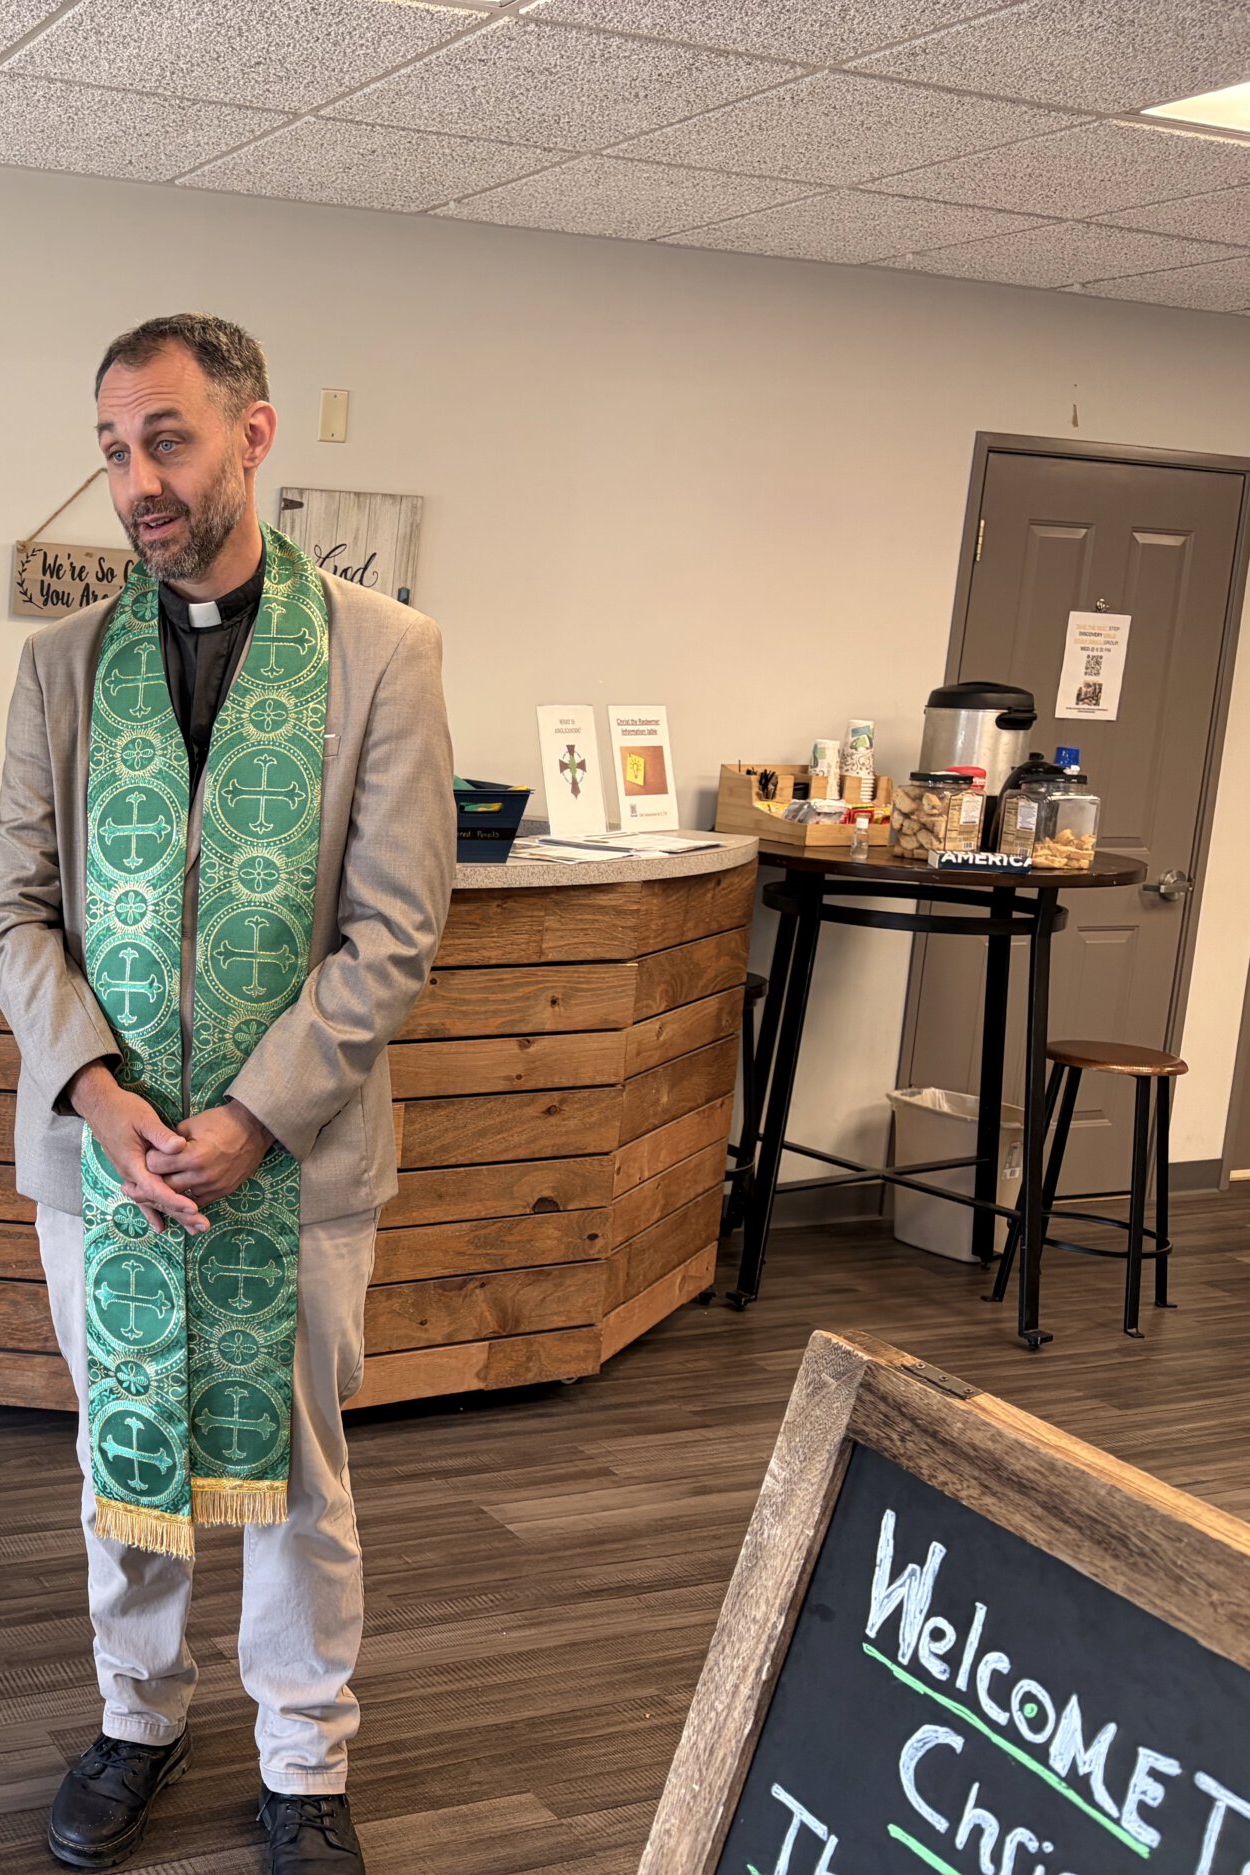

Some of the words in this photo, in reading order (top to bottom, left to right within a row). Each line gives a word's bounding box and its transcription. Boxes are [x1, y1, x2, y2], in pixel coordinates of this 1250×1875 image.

[42, 551, 89, 582] We're
[95, 556, 117, 583] So
[40, 579, 74, 608] You
